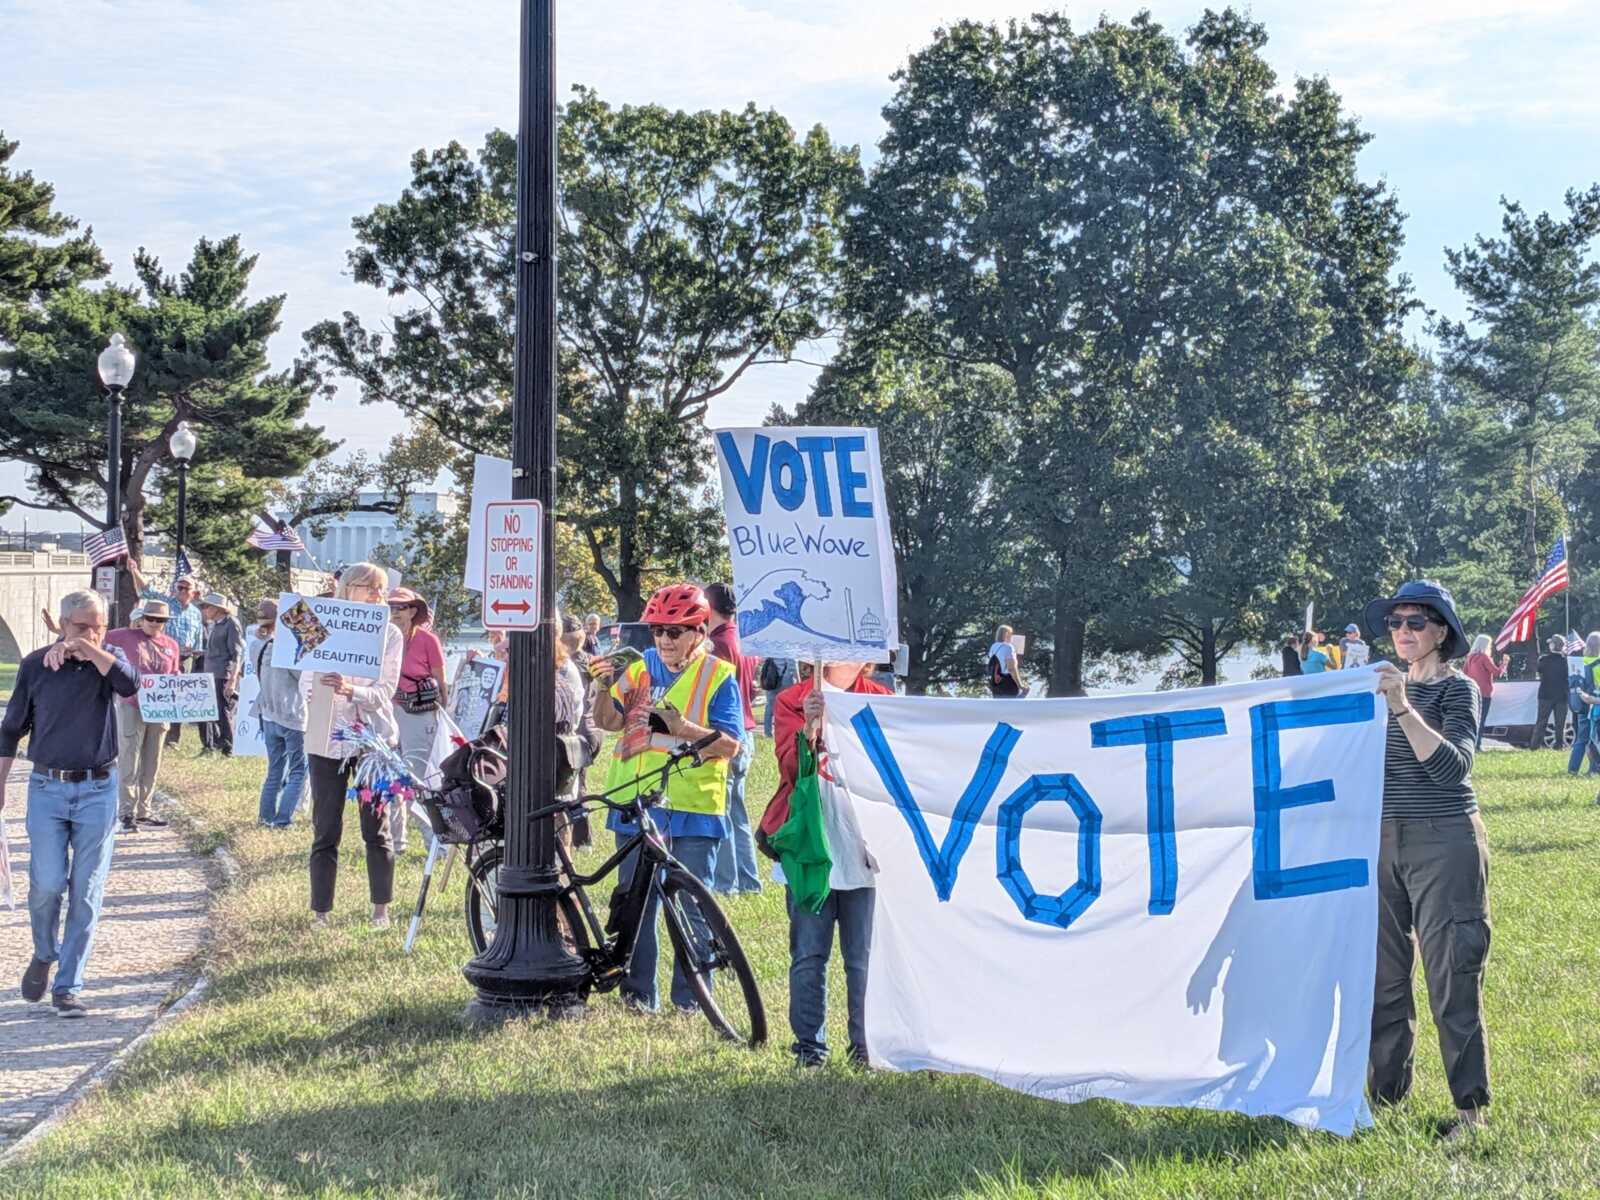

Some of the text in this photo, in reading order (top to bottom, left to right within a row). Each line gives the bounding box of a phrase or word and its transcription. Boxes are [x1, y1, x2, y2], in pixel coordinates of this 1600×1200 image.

[716, 431, 873, 518] VOTE
[504, 514, 520, 533] NO
[491, 538, 533, 553] STOPPING
[505, 556, 518, 571] OR
[490, 574, 533, 590] STANDING
[314, 604, 383, 621] OUR CITY IS
[325, 619, 382, 634] ALREADY
[313, 649, 381, 666] BEAUTIFUL
[146, 690, 176, 703] Nest
[141, 705, 177, 718] Sacred
